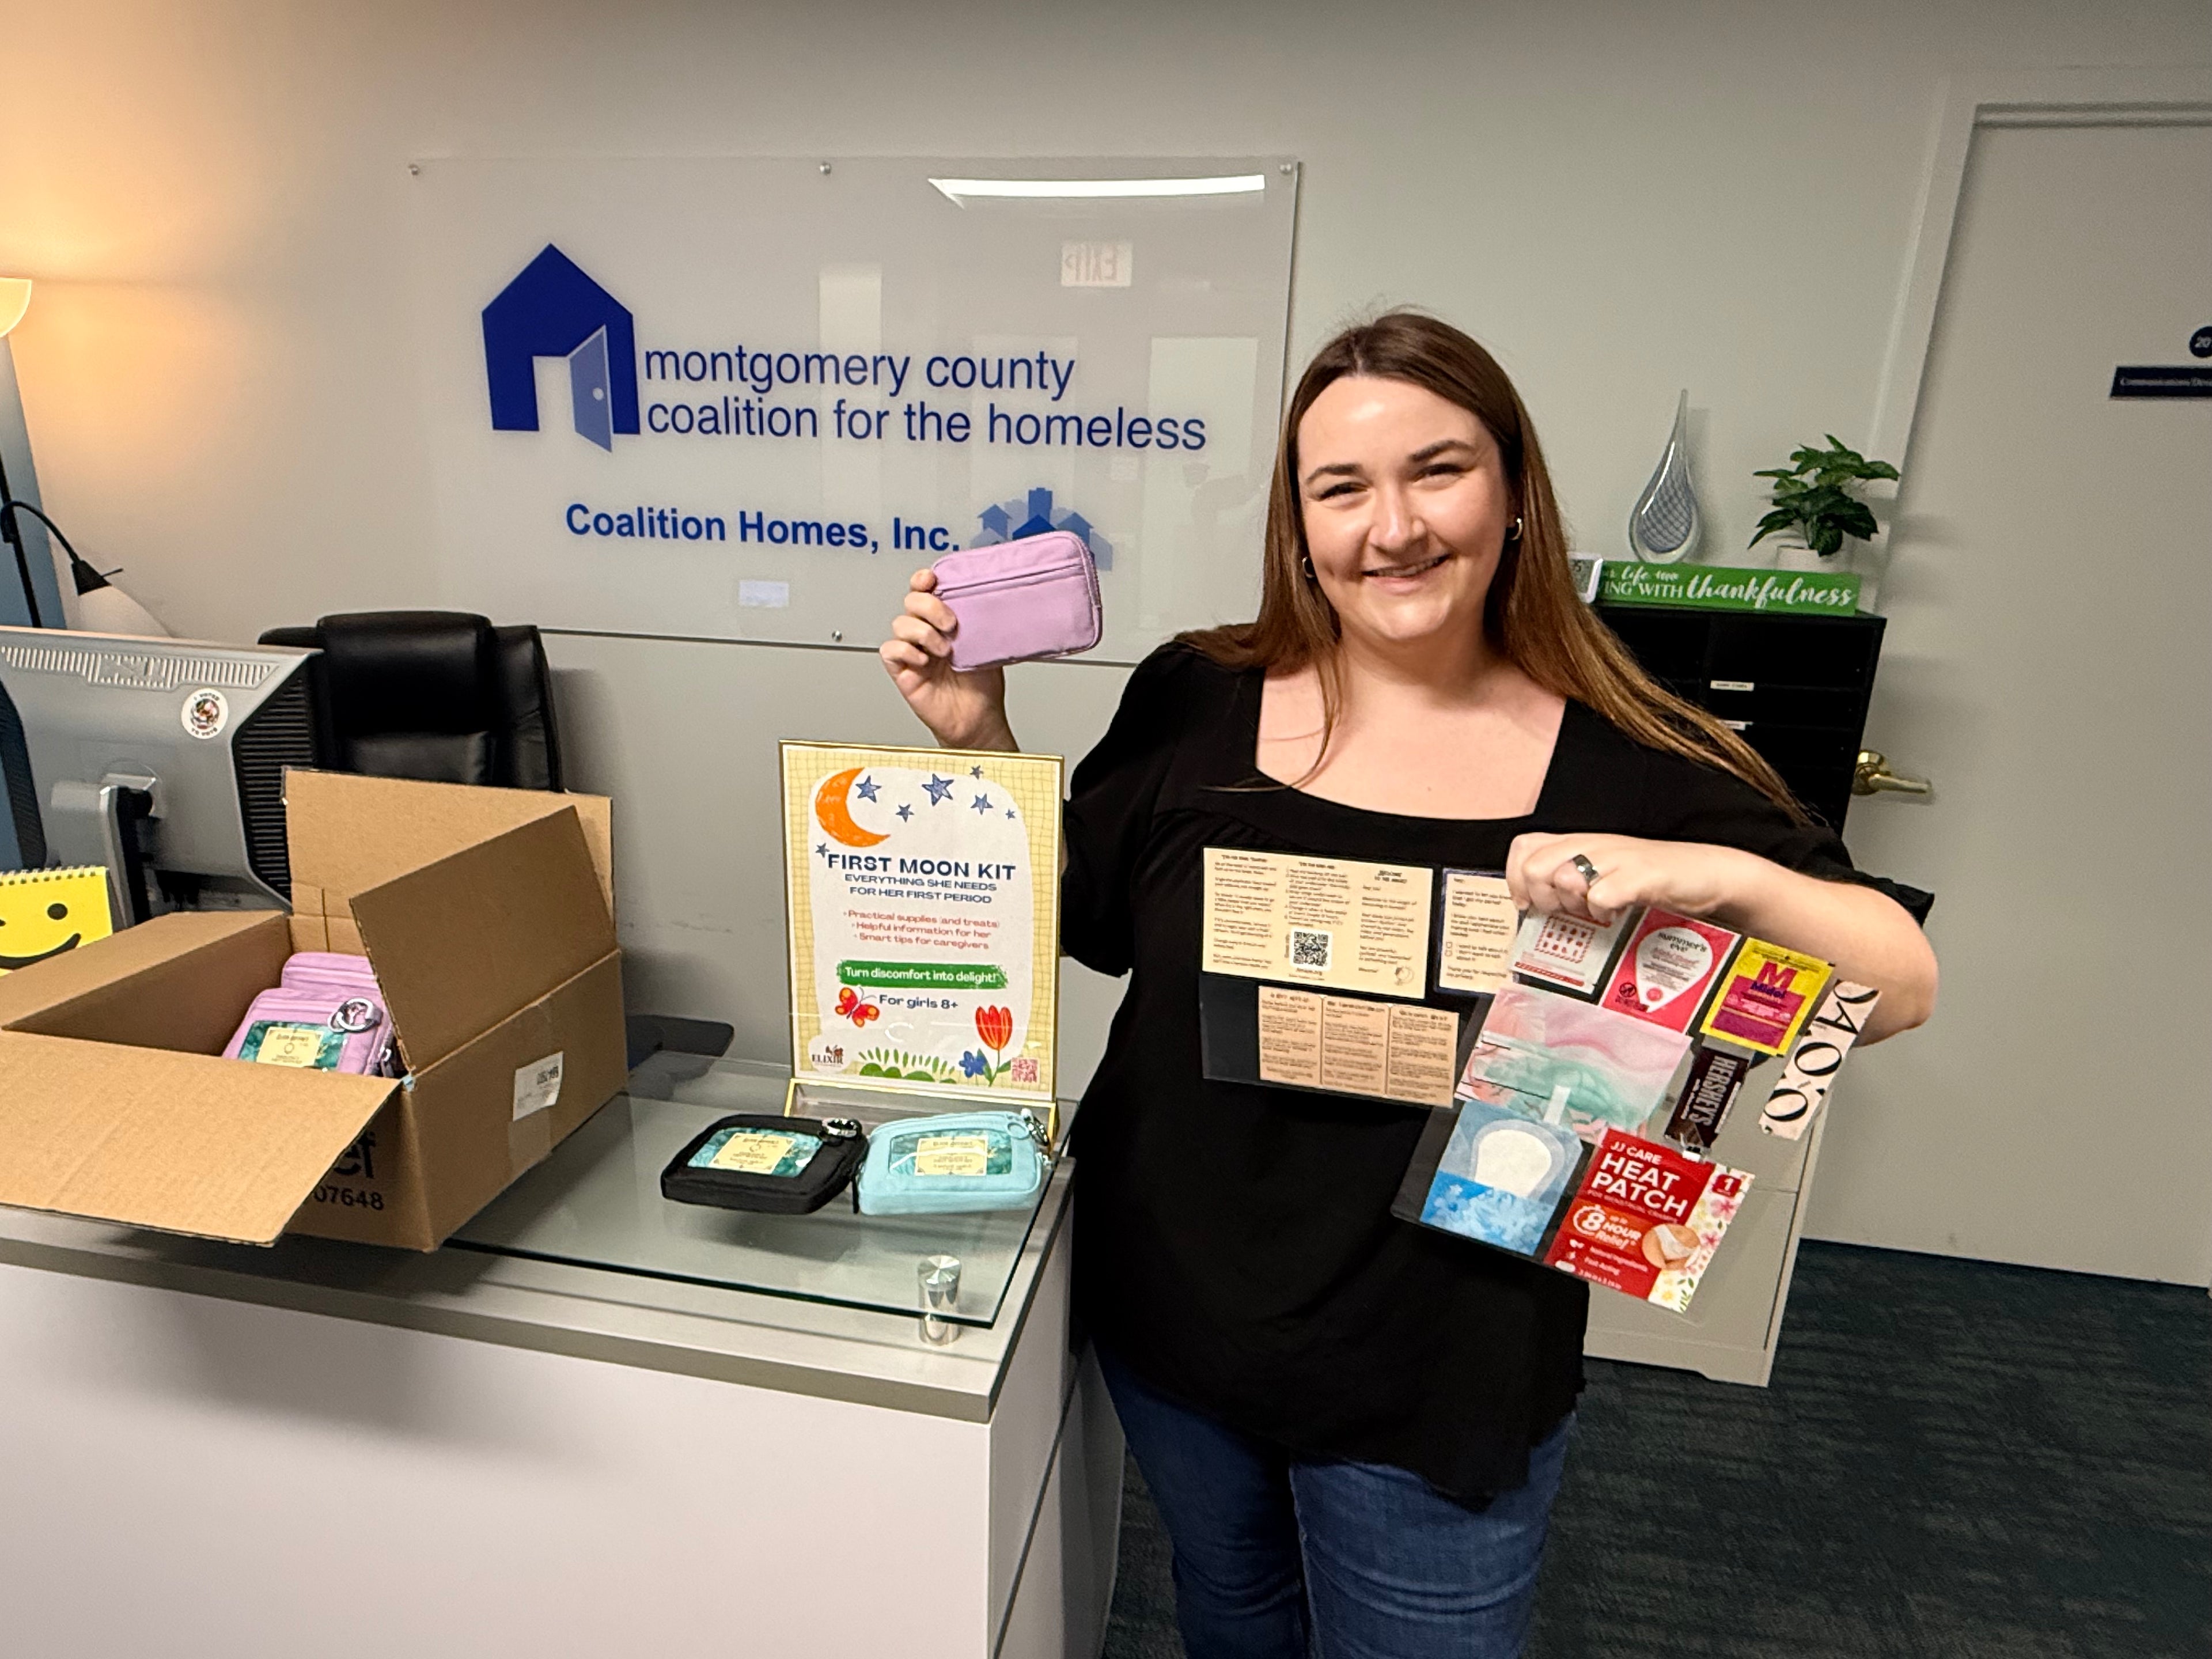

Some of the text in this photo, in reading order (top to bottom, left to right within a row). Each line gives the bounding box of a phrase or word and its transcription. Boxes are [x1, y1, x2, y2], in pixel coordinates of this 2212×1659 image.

[645, 346, 1074, 400] montgomery county
[647, 394, 1206, 450] coalition for the homeless
[566, 503, 960, 553] Coalition Homes, Inc.
[1639, 582, 1683, 598] WITH
[1687, 574, 1857, 609] thankfulness
[828, 854, 1016, 880] FIRST MOON KIT
[844, 873, 997, 891] EVERYTHING SHE NEEDS
[850, 887, 992, 903] FOR HER FIRST PERIOD
[848, 910, 895, 921] Practical
[896, 914, 938, 924] supplies
[856, 922, 991, 938] Helpful information for her
[859, 933, 989, 949] Smart tips for caregivers
[844, 967, 997, 984] Turn discomfort into delight!
[1756, 961, 1798, 991] M
[1750, 981, 1787, 999] Midol
[879, 994, 959, 1009] For girls 8+
[1610, 1141, 1663, 1165] JJ CARE
[1600, 1153, 1681, 1191] HEAT
[1722, 1178, 1733, 1191] 1
[1591, 1172, 1688, 1218] PATCH
[1581, 1211, 1606, 1232] 8
[1602, 1223, 1642, 1241] HOUR
